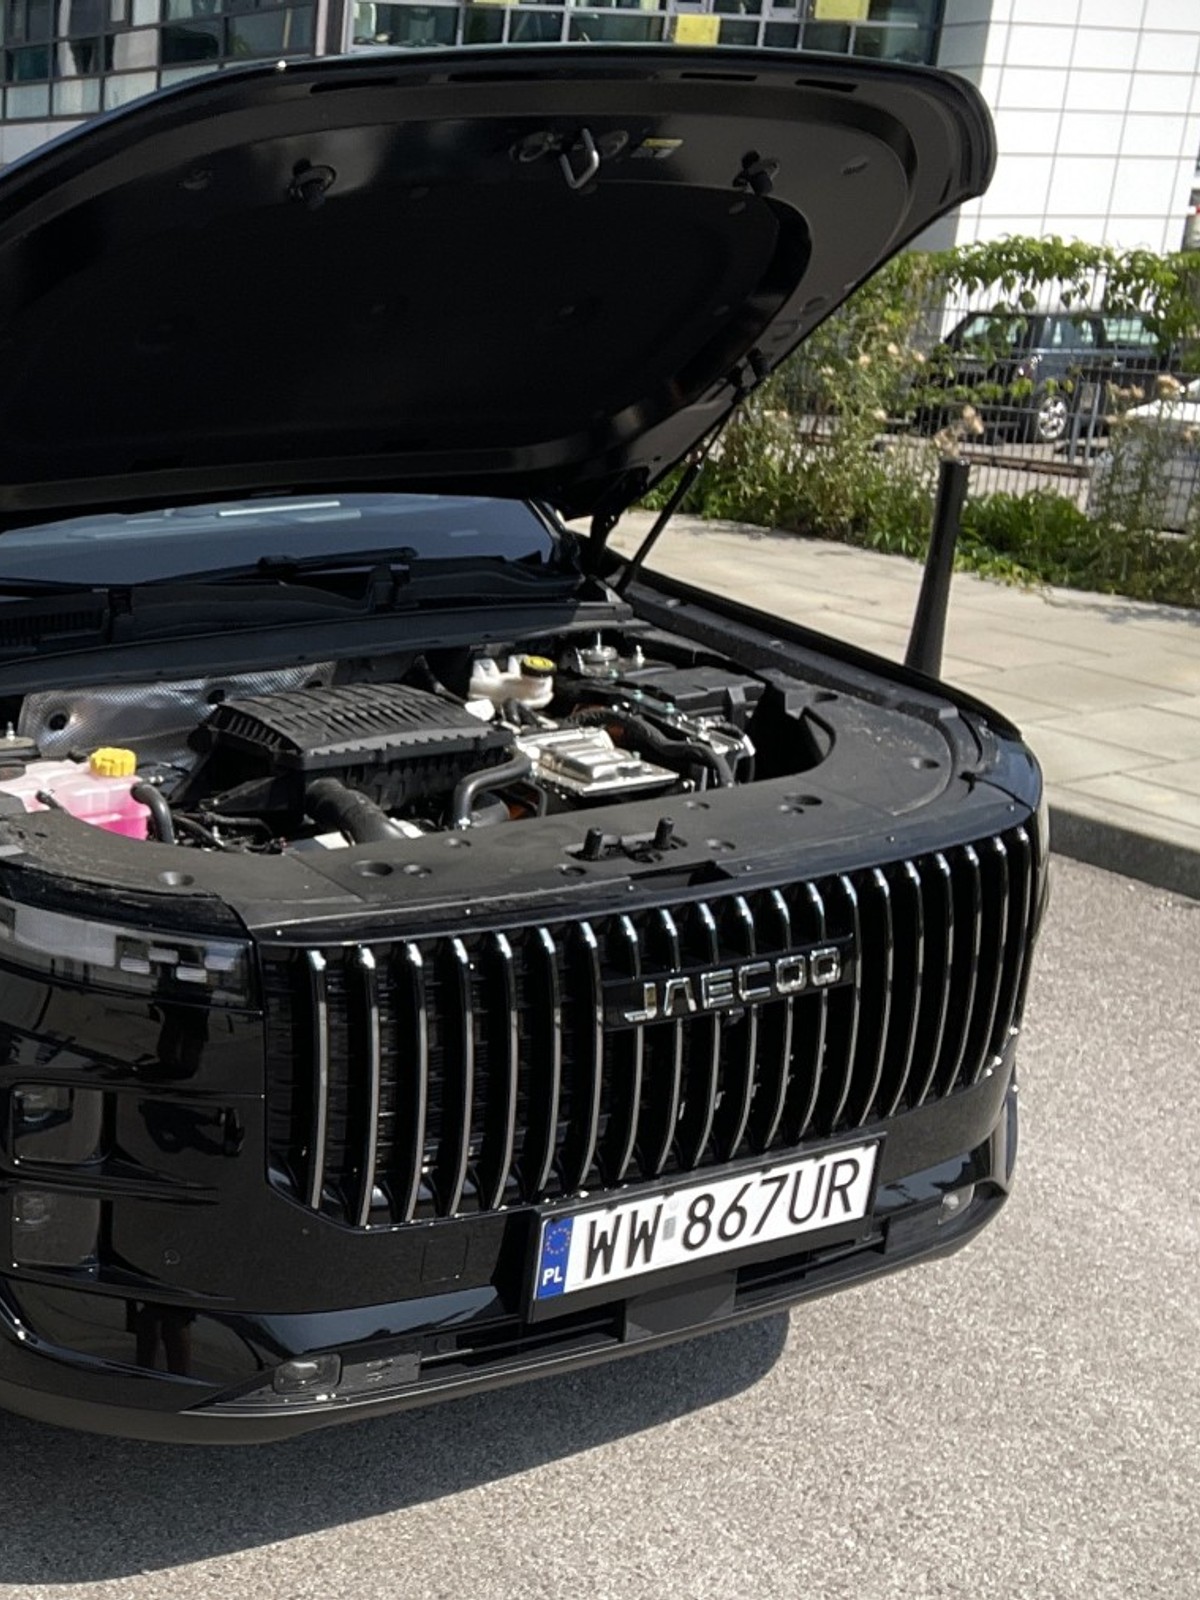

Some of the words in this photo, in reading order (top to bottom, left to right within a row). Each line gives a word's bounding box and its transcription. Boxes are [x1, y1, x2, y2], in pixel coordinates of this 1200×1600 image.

[624, 947, 841, 1022] JAECOO
[584, 1203, 664, 1280] WW
[682, 1158, 860, 1252] 867UR
[542, 1265, 563, 1287] PL
